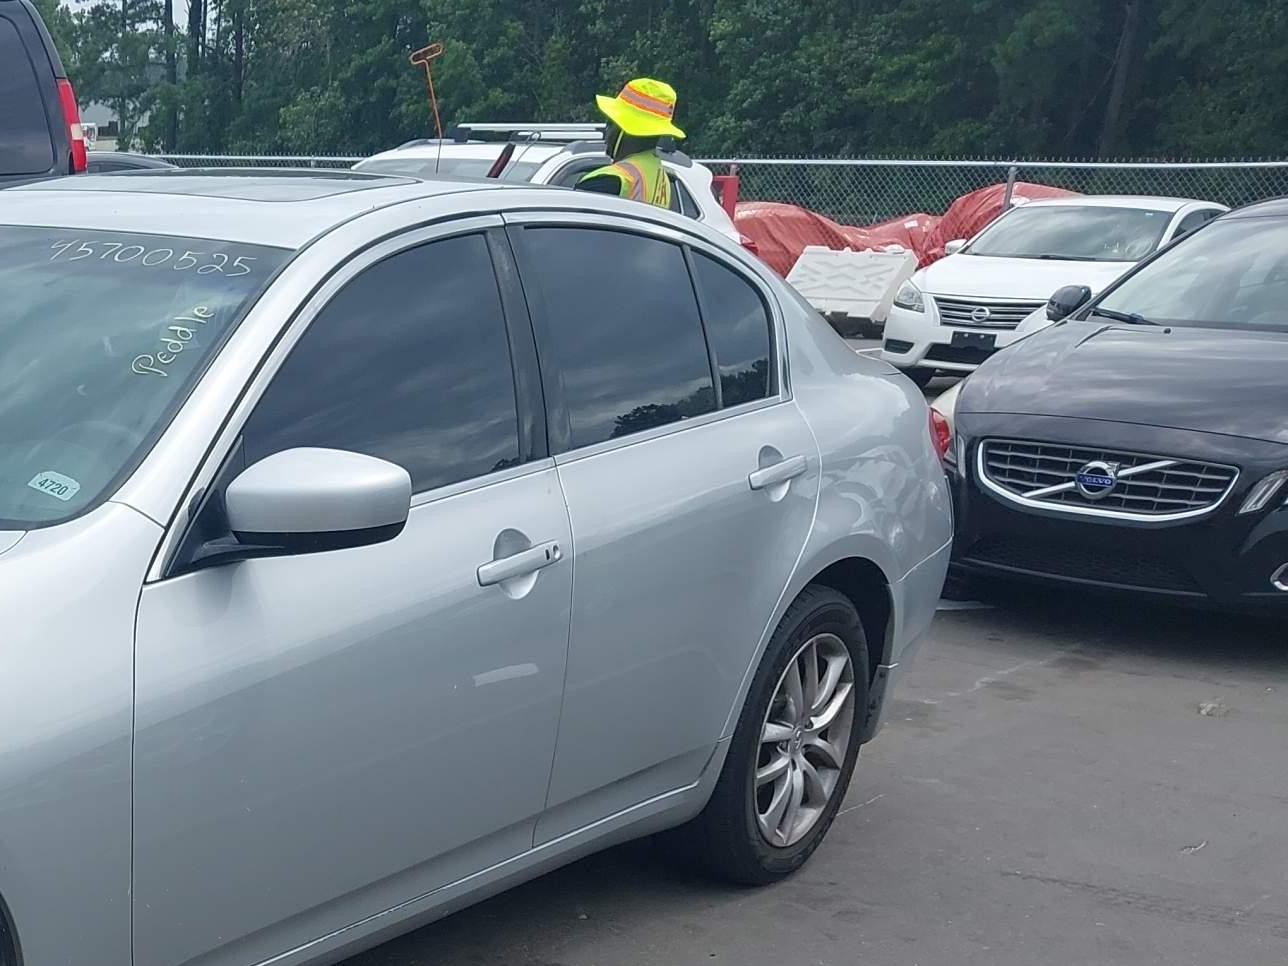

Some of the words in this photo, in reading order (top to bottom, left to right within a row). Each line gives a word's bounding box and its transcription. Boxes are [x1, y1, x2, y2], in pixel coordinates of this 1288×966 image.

[49, 239, 257, 277] 45700525
[131, 305, 215, 377] Peddle
[38, 478, 69, 496] 4720
